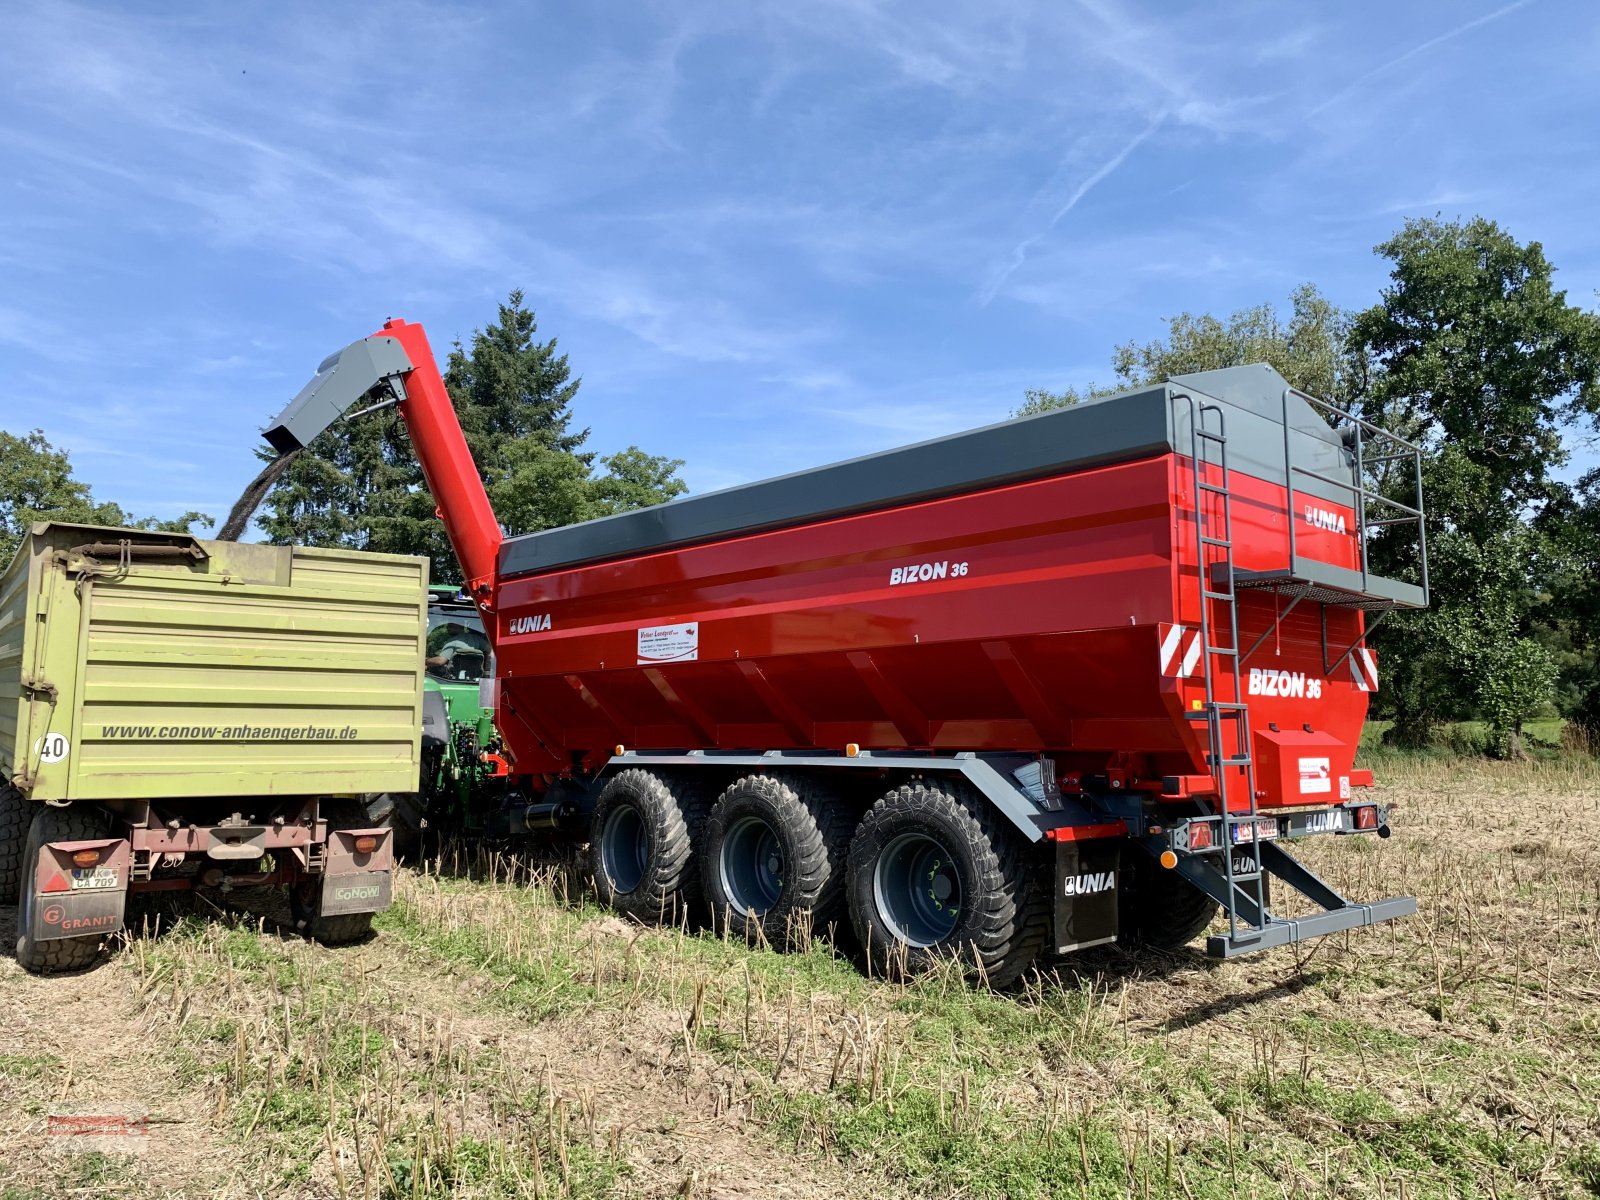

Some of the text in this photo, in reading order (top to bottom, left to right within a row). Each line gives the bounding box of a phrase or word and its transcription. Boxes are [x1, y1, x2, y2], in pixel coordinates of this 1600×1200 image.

[1313, 507, 1346, 535] UNIA
[890, 561, 969, 586] BIZON 36
[517, 613, 552, 634] UNIA
[1248, 667, 1322, 699] BIZON 36
[101, 724, 358, 741] www.conow-anhaengerbau.de
[40, 737, 64, 758] 40
[1312, 811, 1343, 832] UNIA
[77, 878, 113, 888] CA 709
[1075, 871, 1115, 894] UNIA
[62, 916, 116, 929] GRANIT
